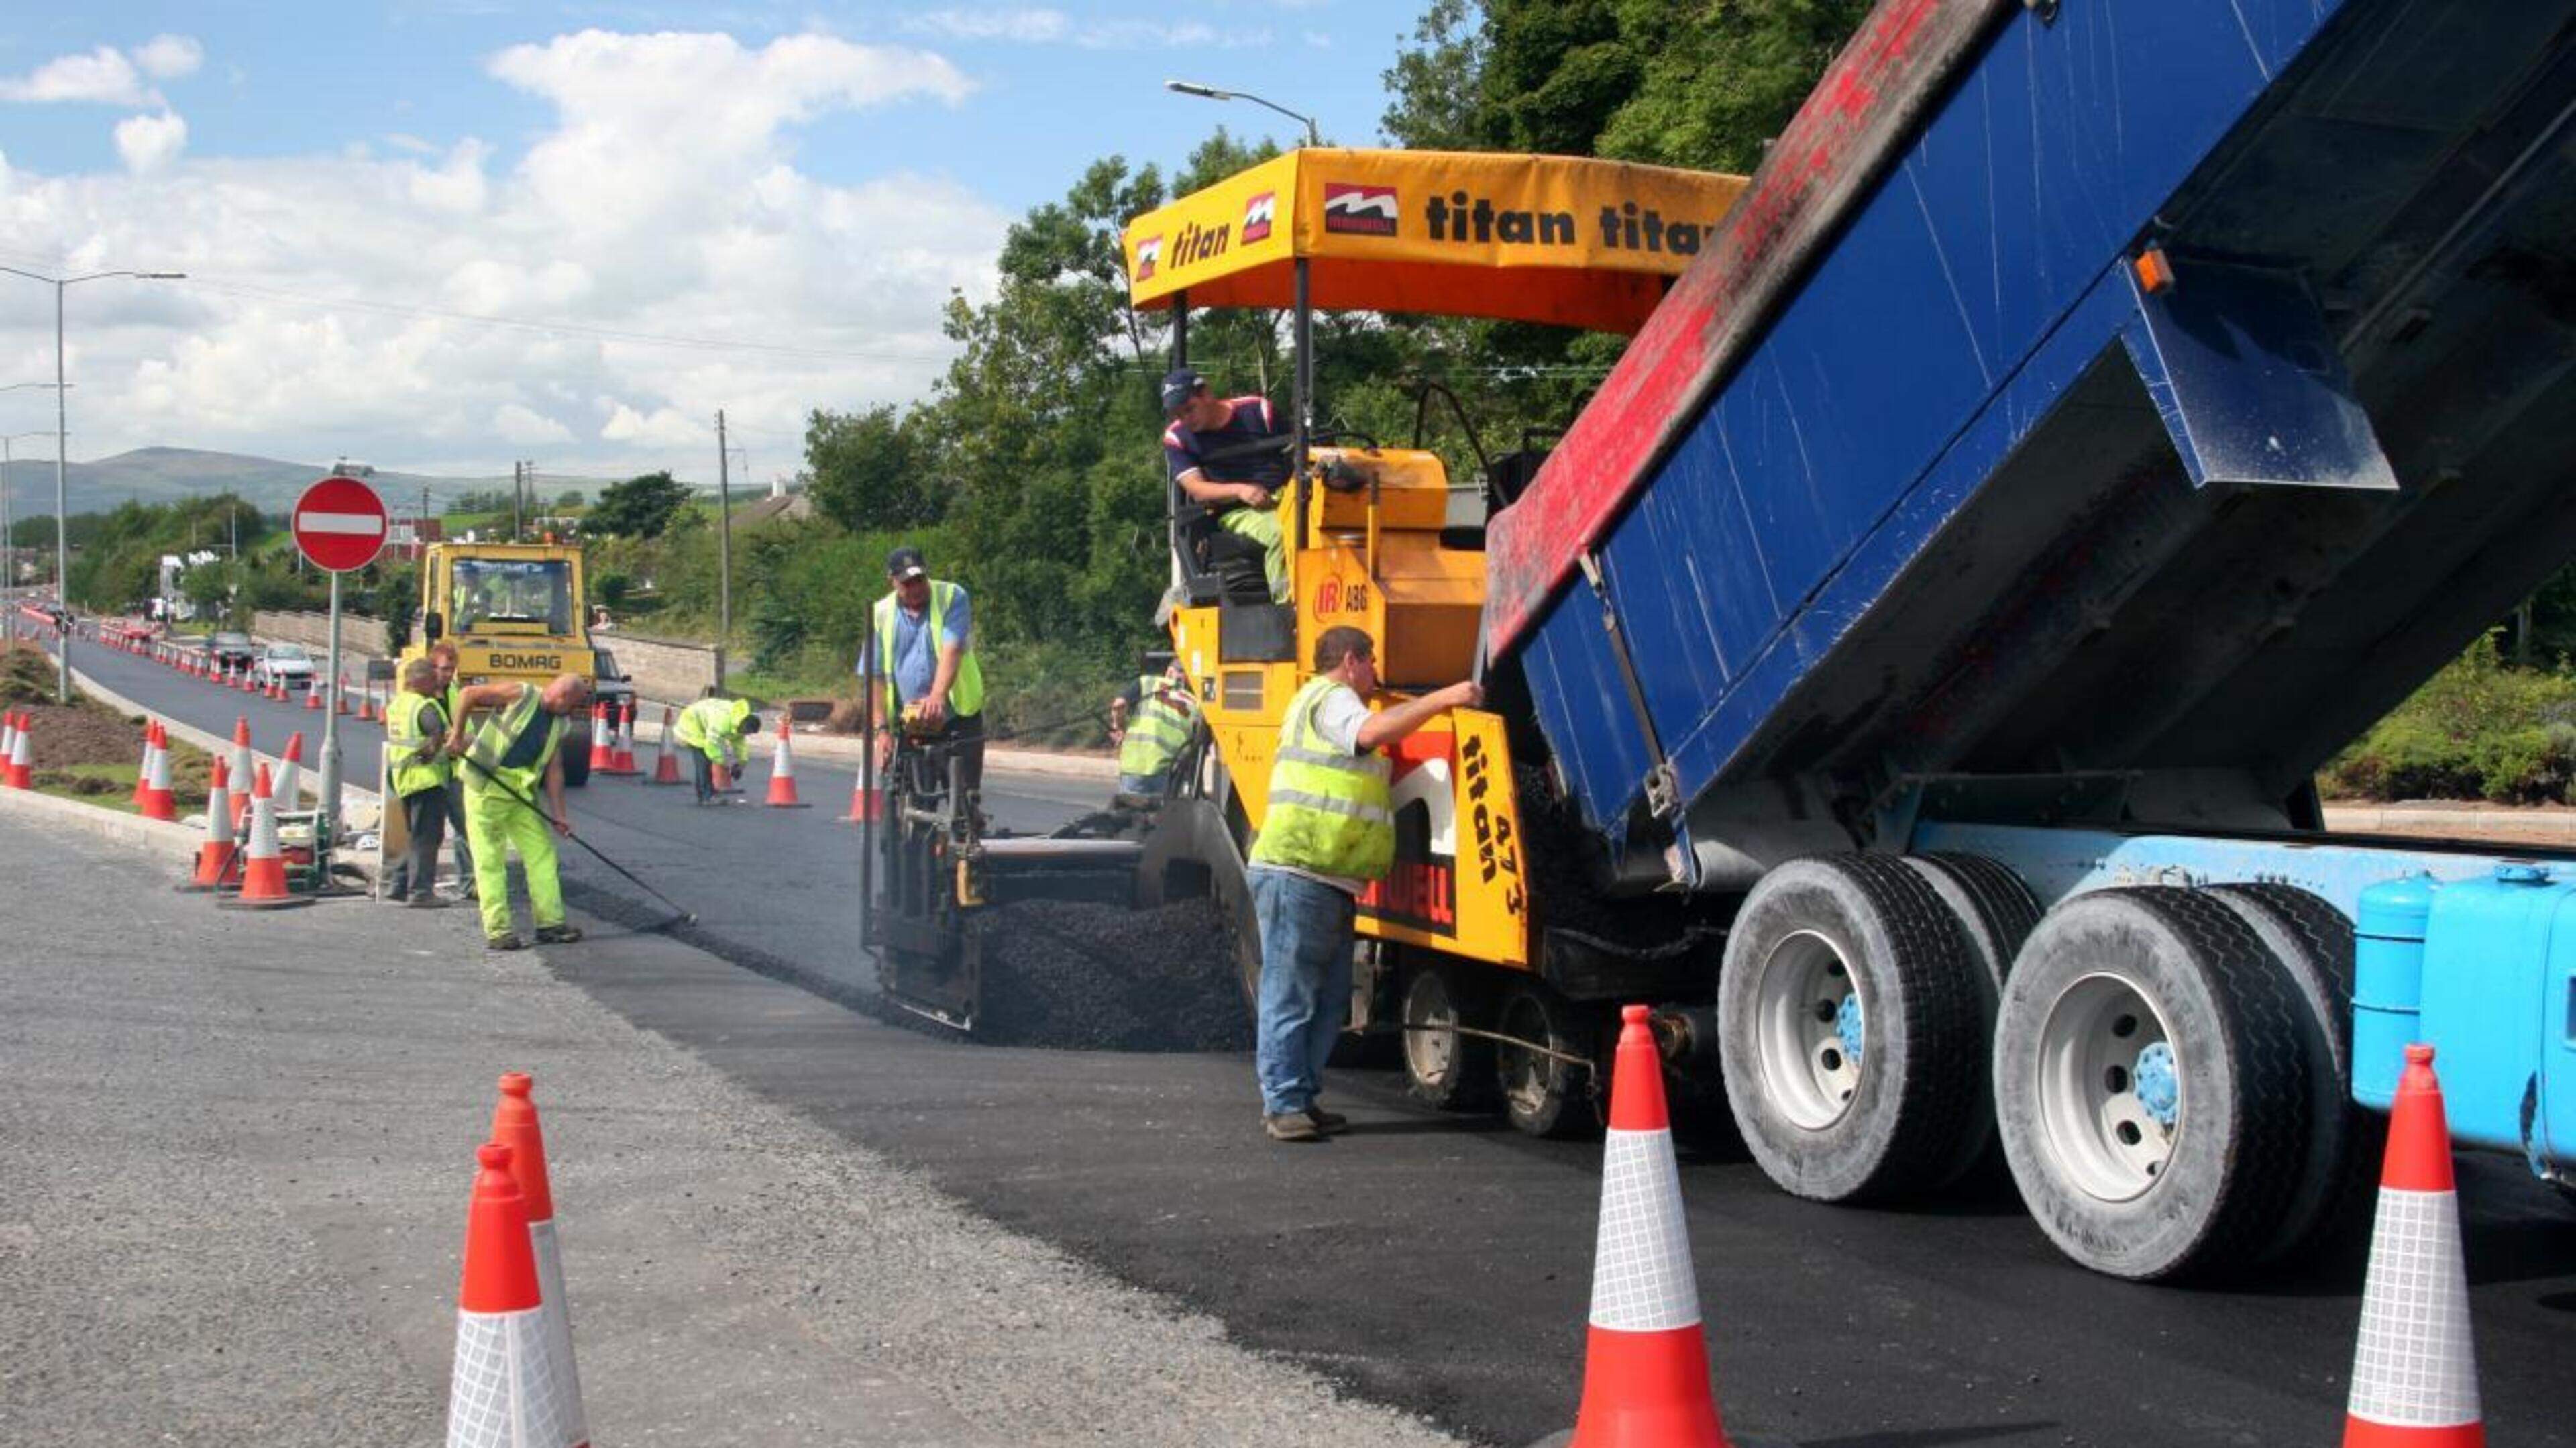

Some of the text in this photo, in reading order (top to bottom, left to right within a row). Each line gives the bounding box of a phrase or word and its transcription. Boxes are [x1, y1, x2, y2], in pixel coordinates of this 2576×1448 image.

[1426, 191, 1576, 244] titan
[1170, 221, 1230, 270] titan
[1346, 584, 1368, 613] ABG
[490, 654, 562, 670] BOMAG
[1462, 734, 1497, 884] titan
